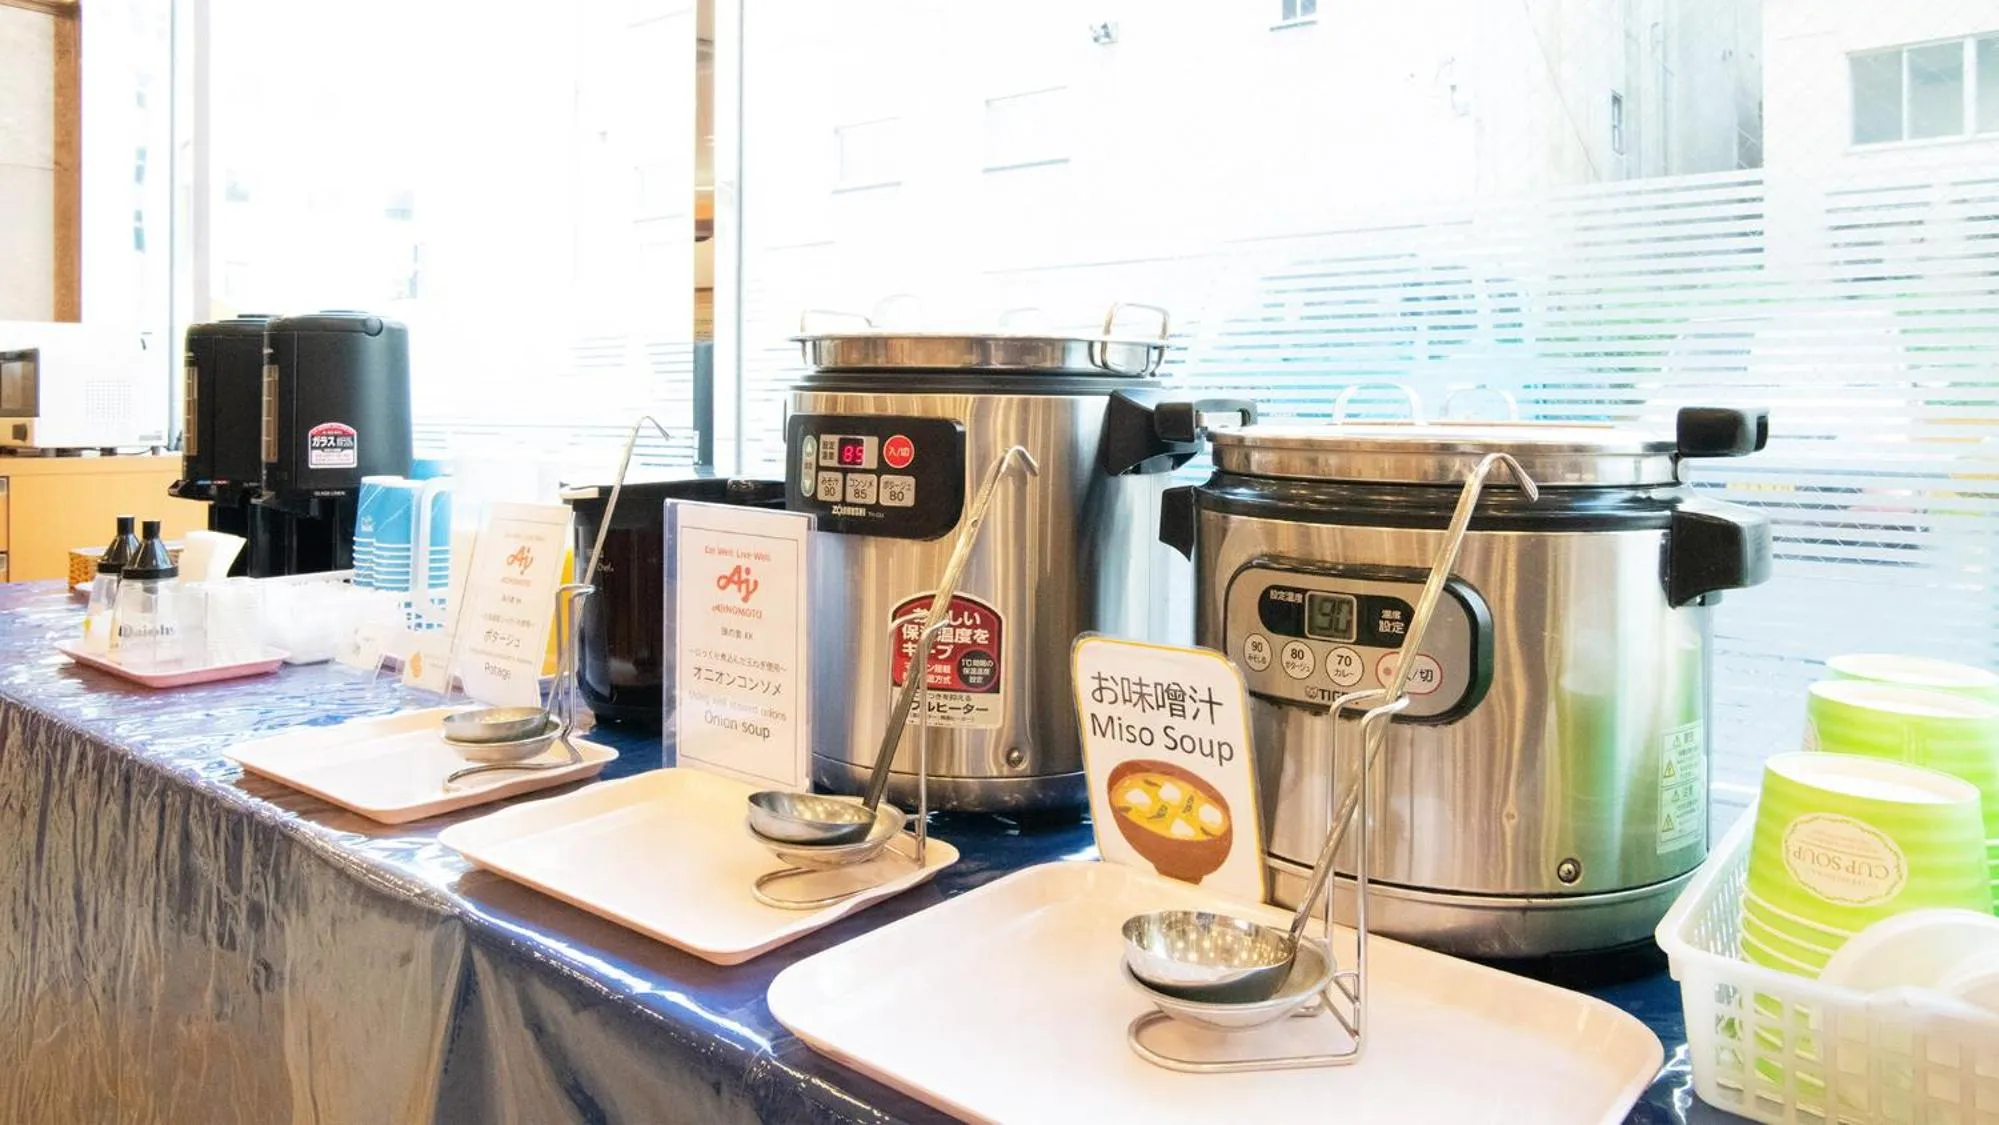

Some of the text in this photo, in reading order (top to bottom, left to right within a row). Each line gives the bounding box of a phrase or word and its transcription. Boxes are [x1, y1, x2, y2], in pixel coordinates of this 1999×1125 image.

[312, 436, 336, 448] ガラス
[843, 445, 864, 462] 85
[848, 478, 873, 489] コンソメ
[883, 480, 912, 491] ポタージュ
[824, 486, 837, 497] 90
[853, 489, 868, 500] 85
[889, 491, 905, 502] 80
[1269, 589, 1303, 604] 設定温度
[1381, 609, 1403, 620] 温度
[902, 623, 990, 645] 保温度を
[1378, 620, 1406, 635] 設定
[902, 641, 954, 660] キプ
[1251, 641, 1264, 653] 90
[1290, 648, 1305, 660] 80
[1285, 660, 1311, 673] ポタージュ
[1336, 655, 1352, 667] 70
[1334, 669, 1355, 679] カレー
[693, 666, 782, 696] オニオンコンソメ
[1090, 671, 1224, 725] お味噌汁
[704, 709, 771, 742] Onion soup
[1090, 712, 1234, 767] Miso Soup
[1793, 847, 1842, 872] SOUP
[1845, 860, 1890, 880] CUP
